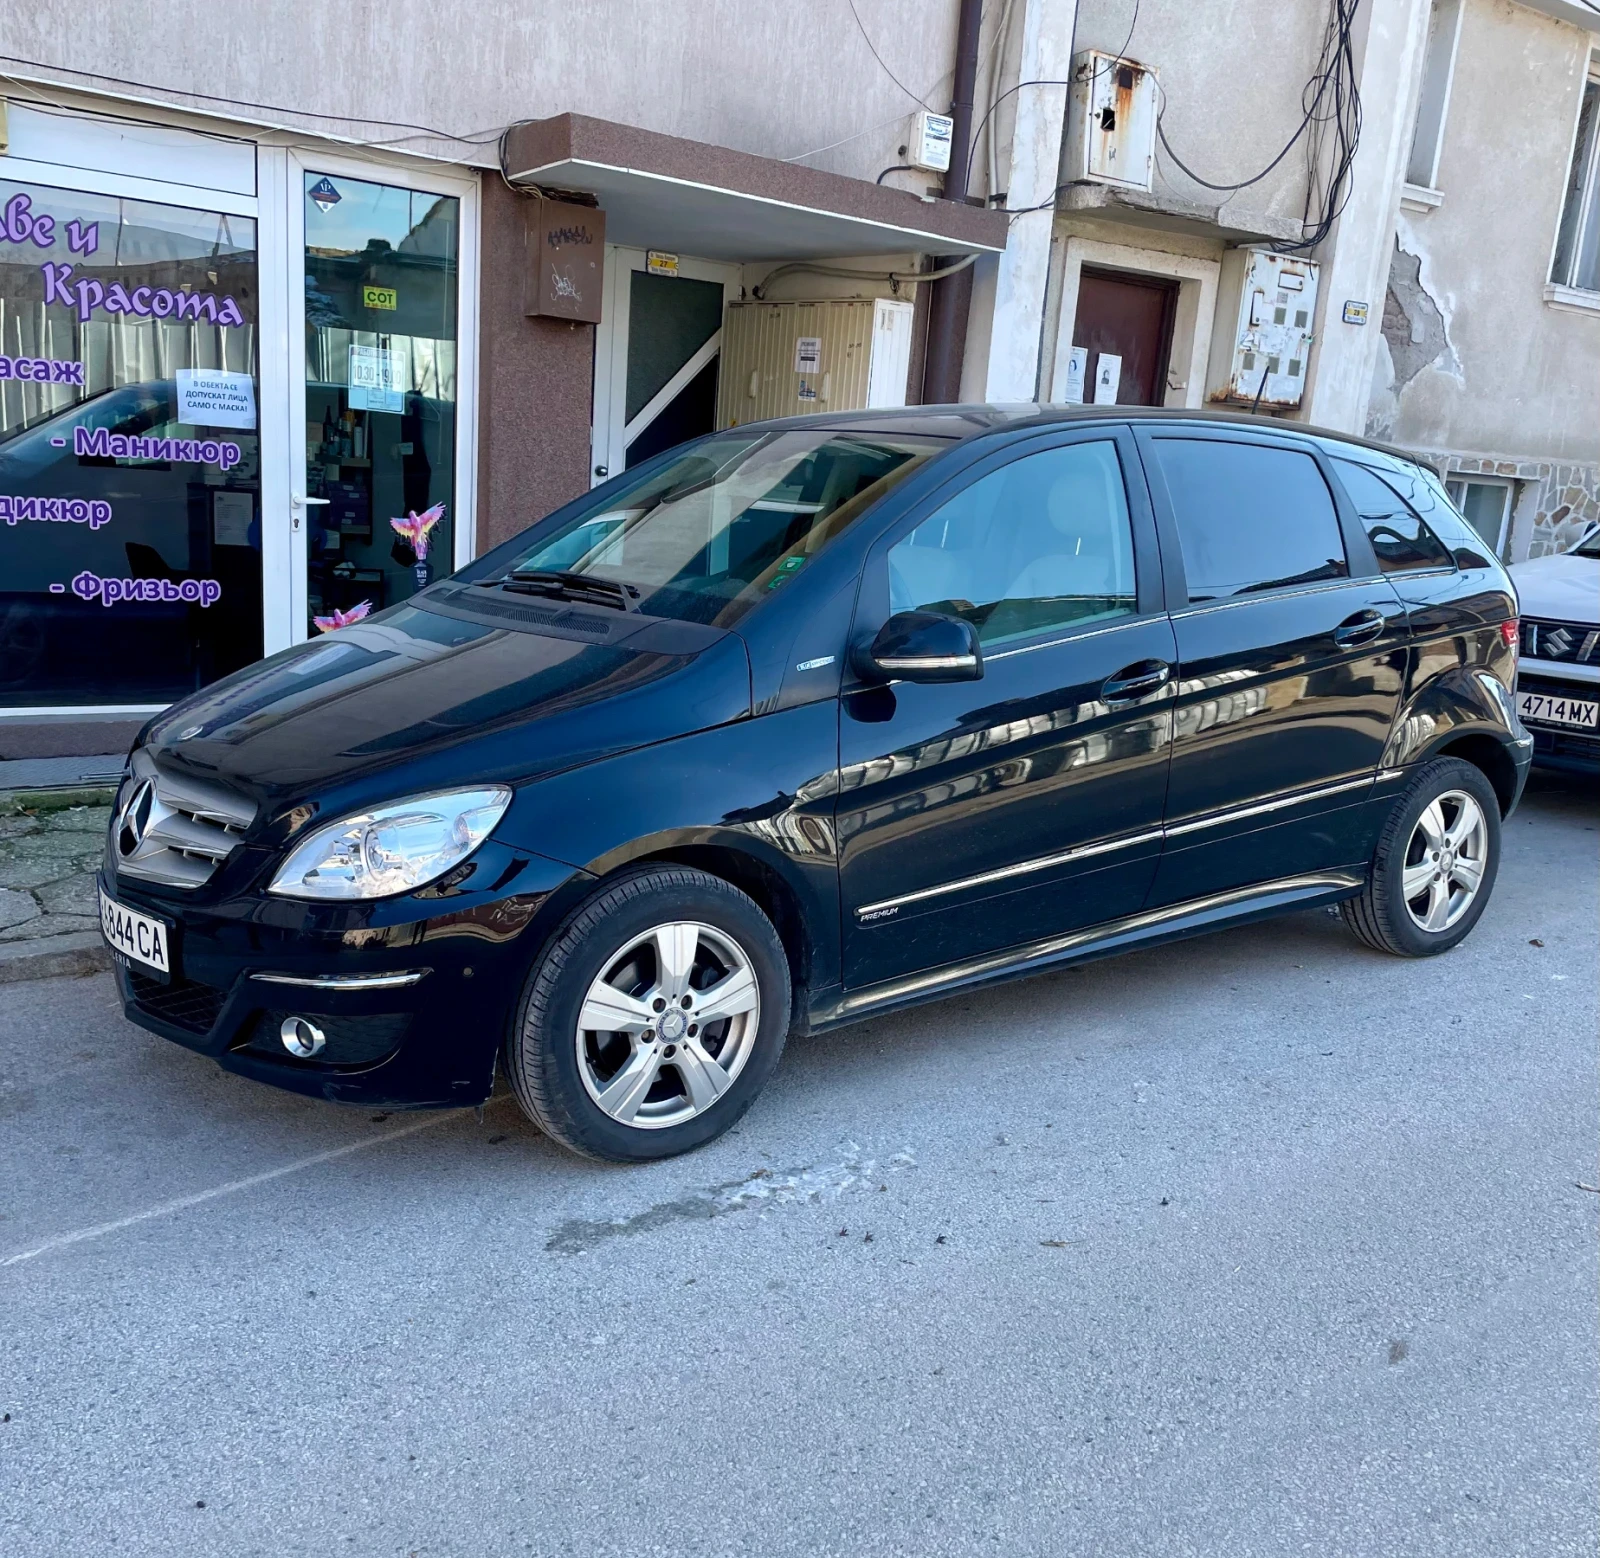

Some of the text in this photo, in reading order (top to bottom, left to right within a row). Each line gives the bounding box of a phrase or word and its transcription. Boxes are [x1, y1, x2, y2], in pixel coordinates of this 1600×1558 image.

[64, 220, 99, 257] и
[659, 260, 668, 268] 27
[41, 261, 245, 328] Красота
[367, 291, 393, 304] СОТ
[354, 365, 375, 382] 10.30
[200, 381, 229, 390] ОБЕКТА
[186, 390, 248, 402] ДОПУСКАТ ЛИЦА
[187, 401, 211, 409] САМО
[218, 403, 248, 412] МАСКА!
[73, 426, 240, 470] Маникюр
[72, 571, 221, 607] Фризьор
[860, 906, 899, 922] PREMIUM
